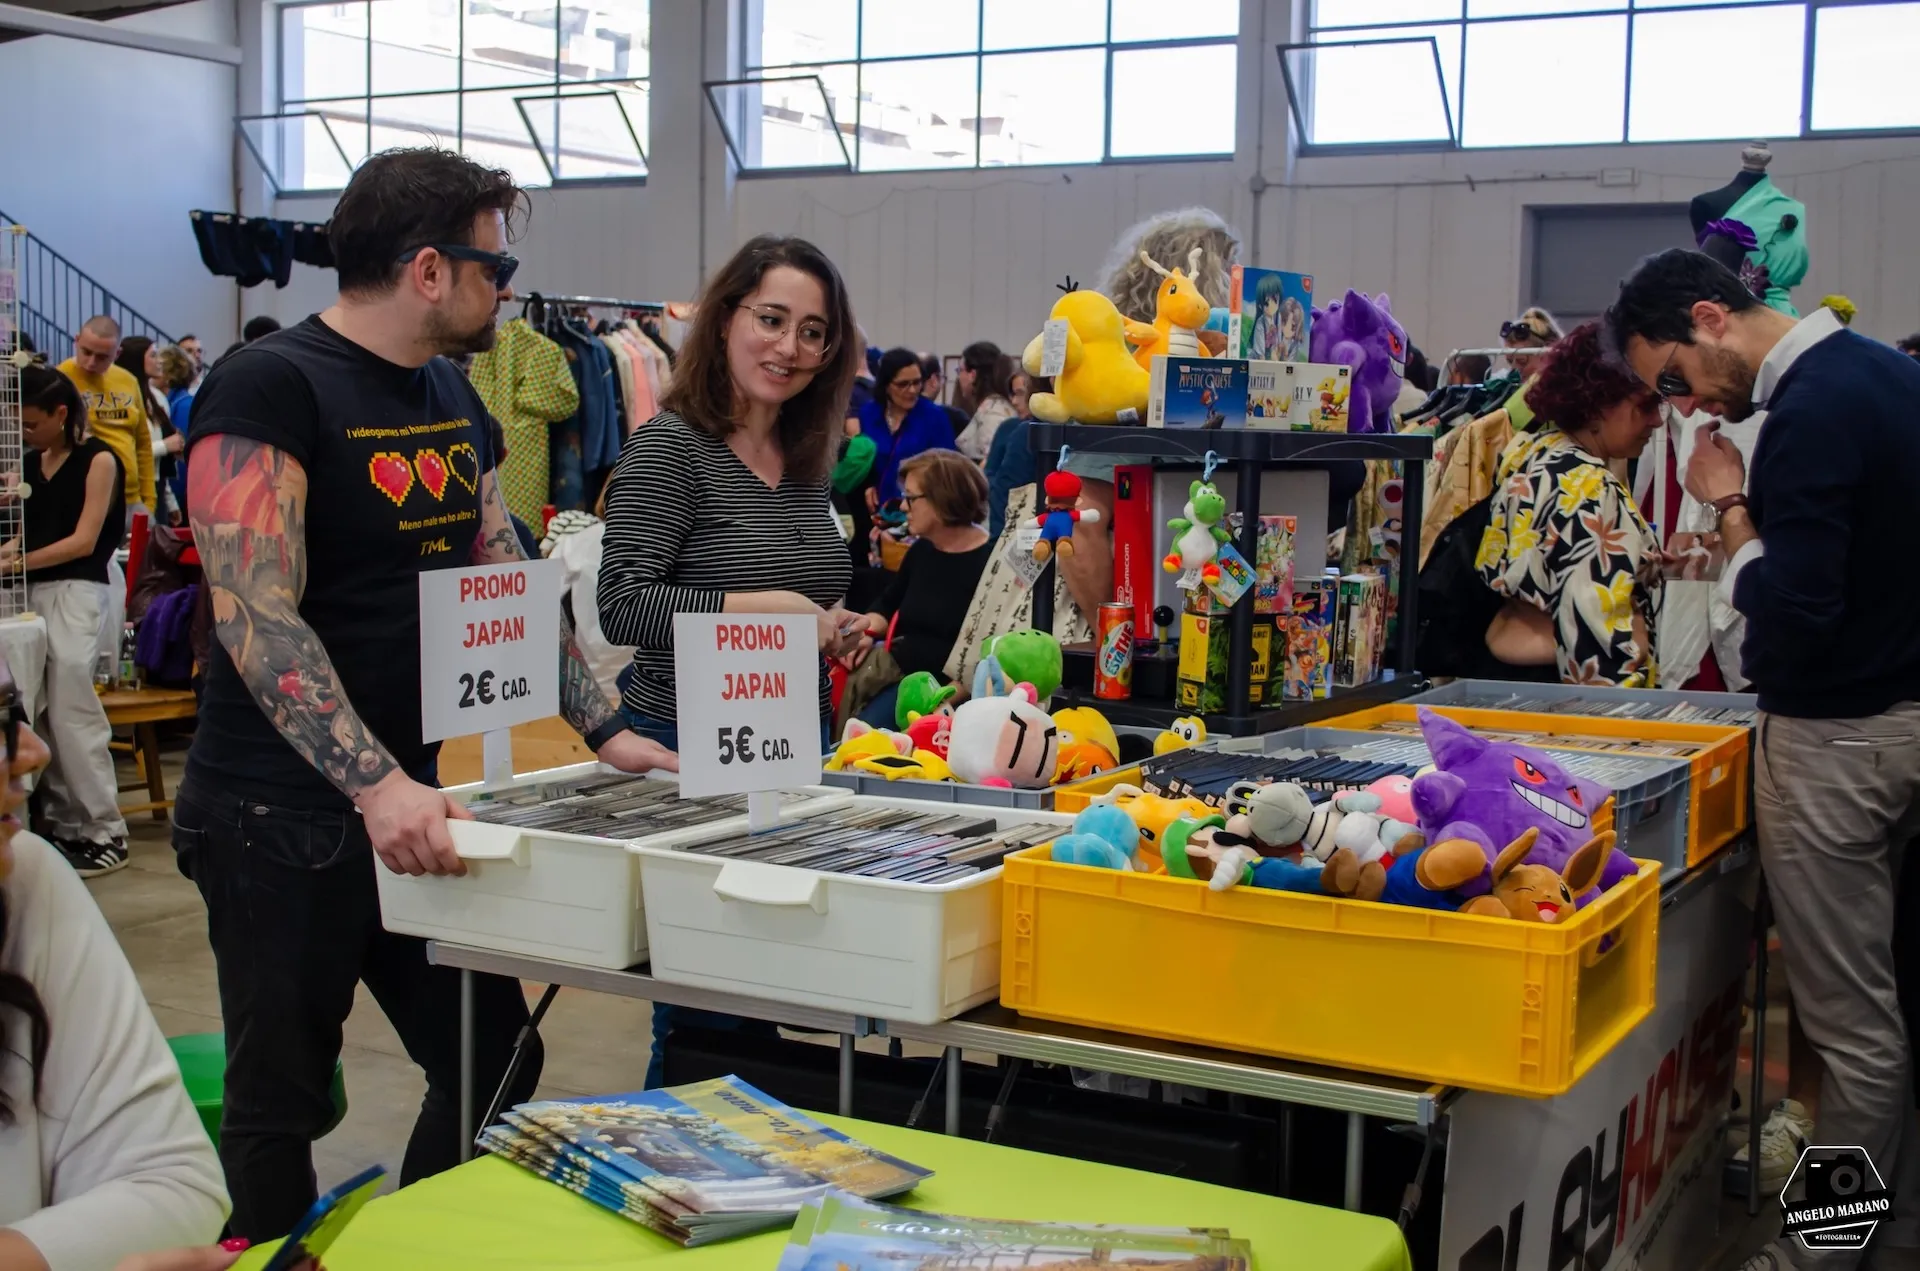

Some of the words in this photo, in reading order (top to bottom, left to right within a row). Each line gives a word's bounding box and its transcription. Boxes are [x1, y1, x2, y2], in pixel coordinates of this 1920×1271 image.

[1179, 373, 1204, 388] MYSTIC
[1205, 373, 1232, 389] QUEST
[346, 428, 351, 439] I
[351, 427, 400, 439] videogames
[399, 426, 410, 437] mi
[399, 520, 422, 531] Meno
[423, 516, 438, 527] male
[439, 516, 447, 524] ne
[447, 513, 456, 523] ho
[420, 537, 452, 556] TML
[460, 572, 526, 601] PROMO
[463, 617, 525, 649] JAPAN
[716, 624, 786, 651] PROMO
[458, 669, 496, 709] 2€
[501, 676, 531, 701] CAD.
[721, 672, 786, 701] JAPAN
[718, 725, 756, 765] 5€
[762, 738, 794, 762] CAD.
